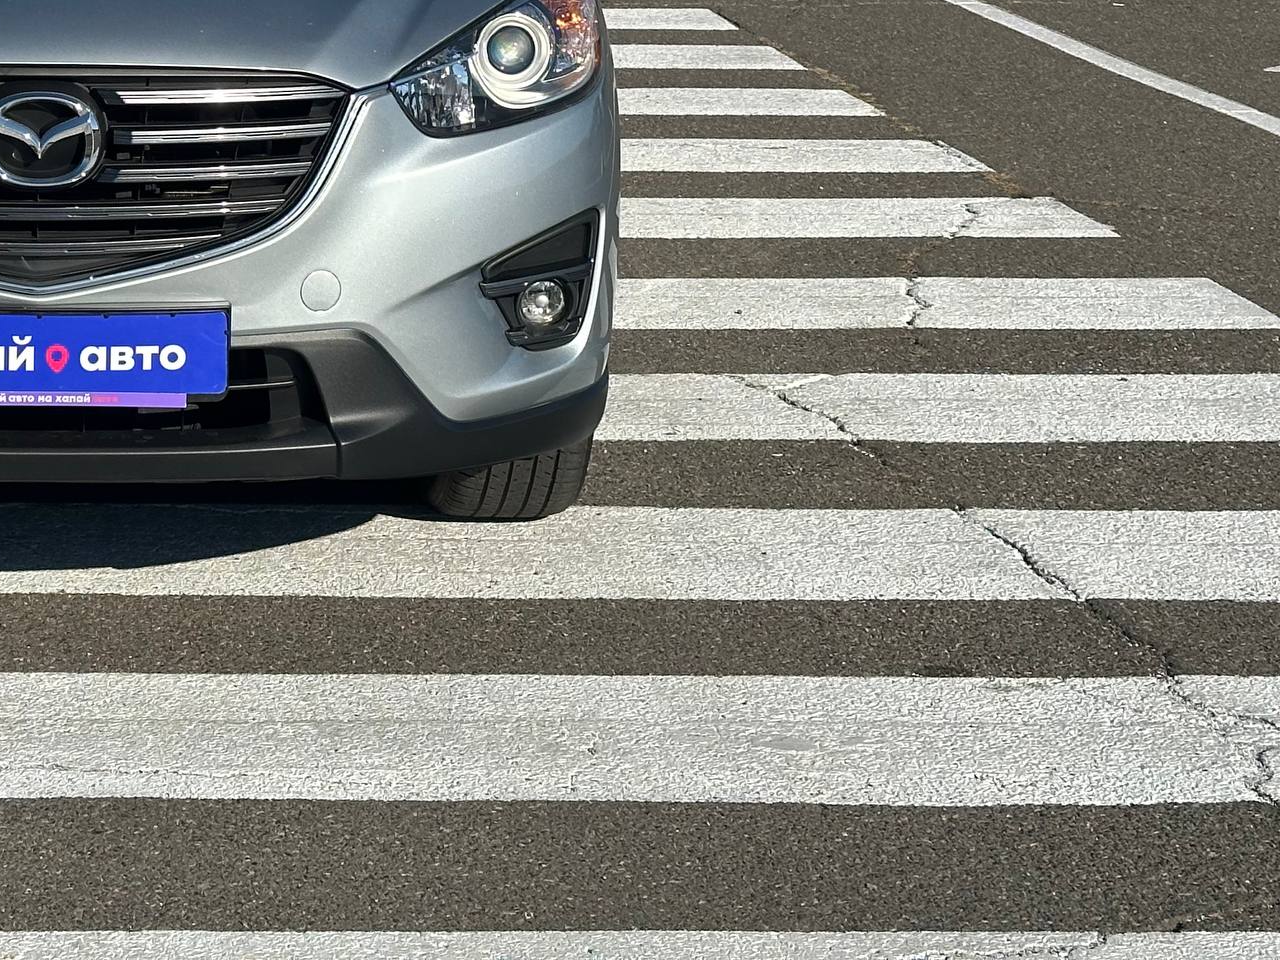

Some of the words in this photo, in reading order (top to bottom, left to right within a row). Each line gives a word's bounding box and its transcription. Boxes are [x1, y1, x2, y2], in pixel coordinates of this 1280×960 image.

[80, 344, 186, 371] авто
[8, 394, 35, 403] авто
[37, 395, 53, 403] на
[55, 392, 91, 403] хапай
